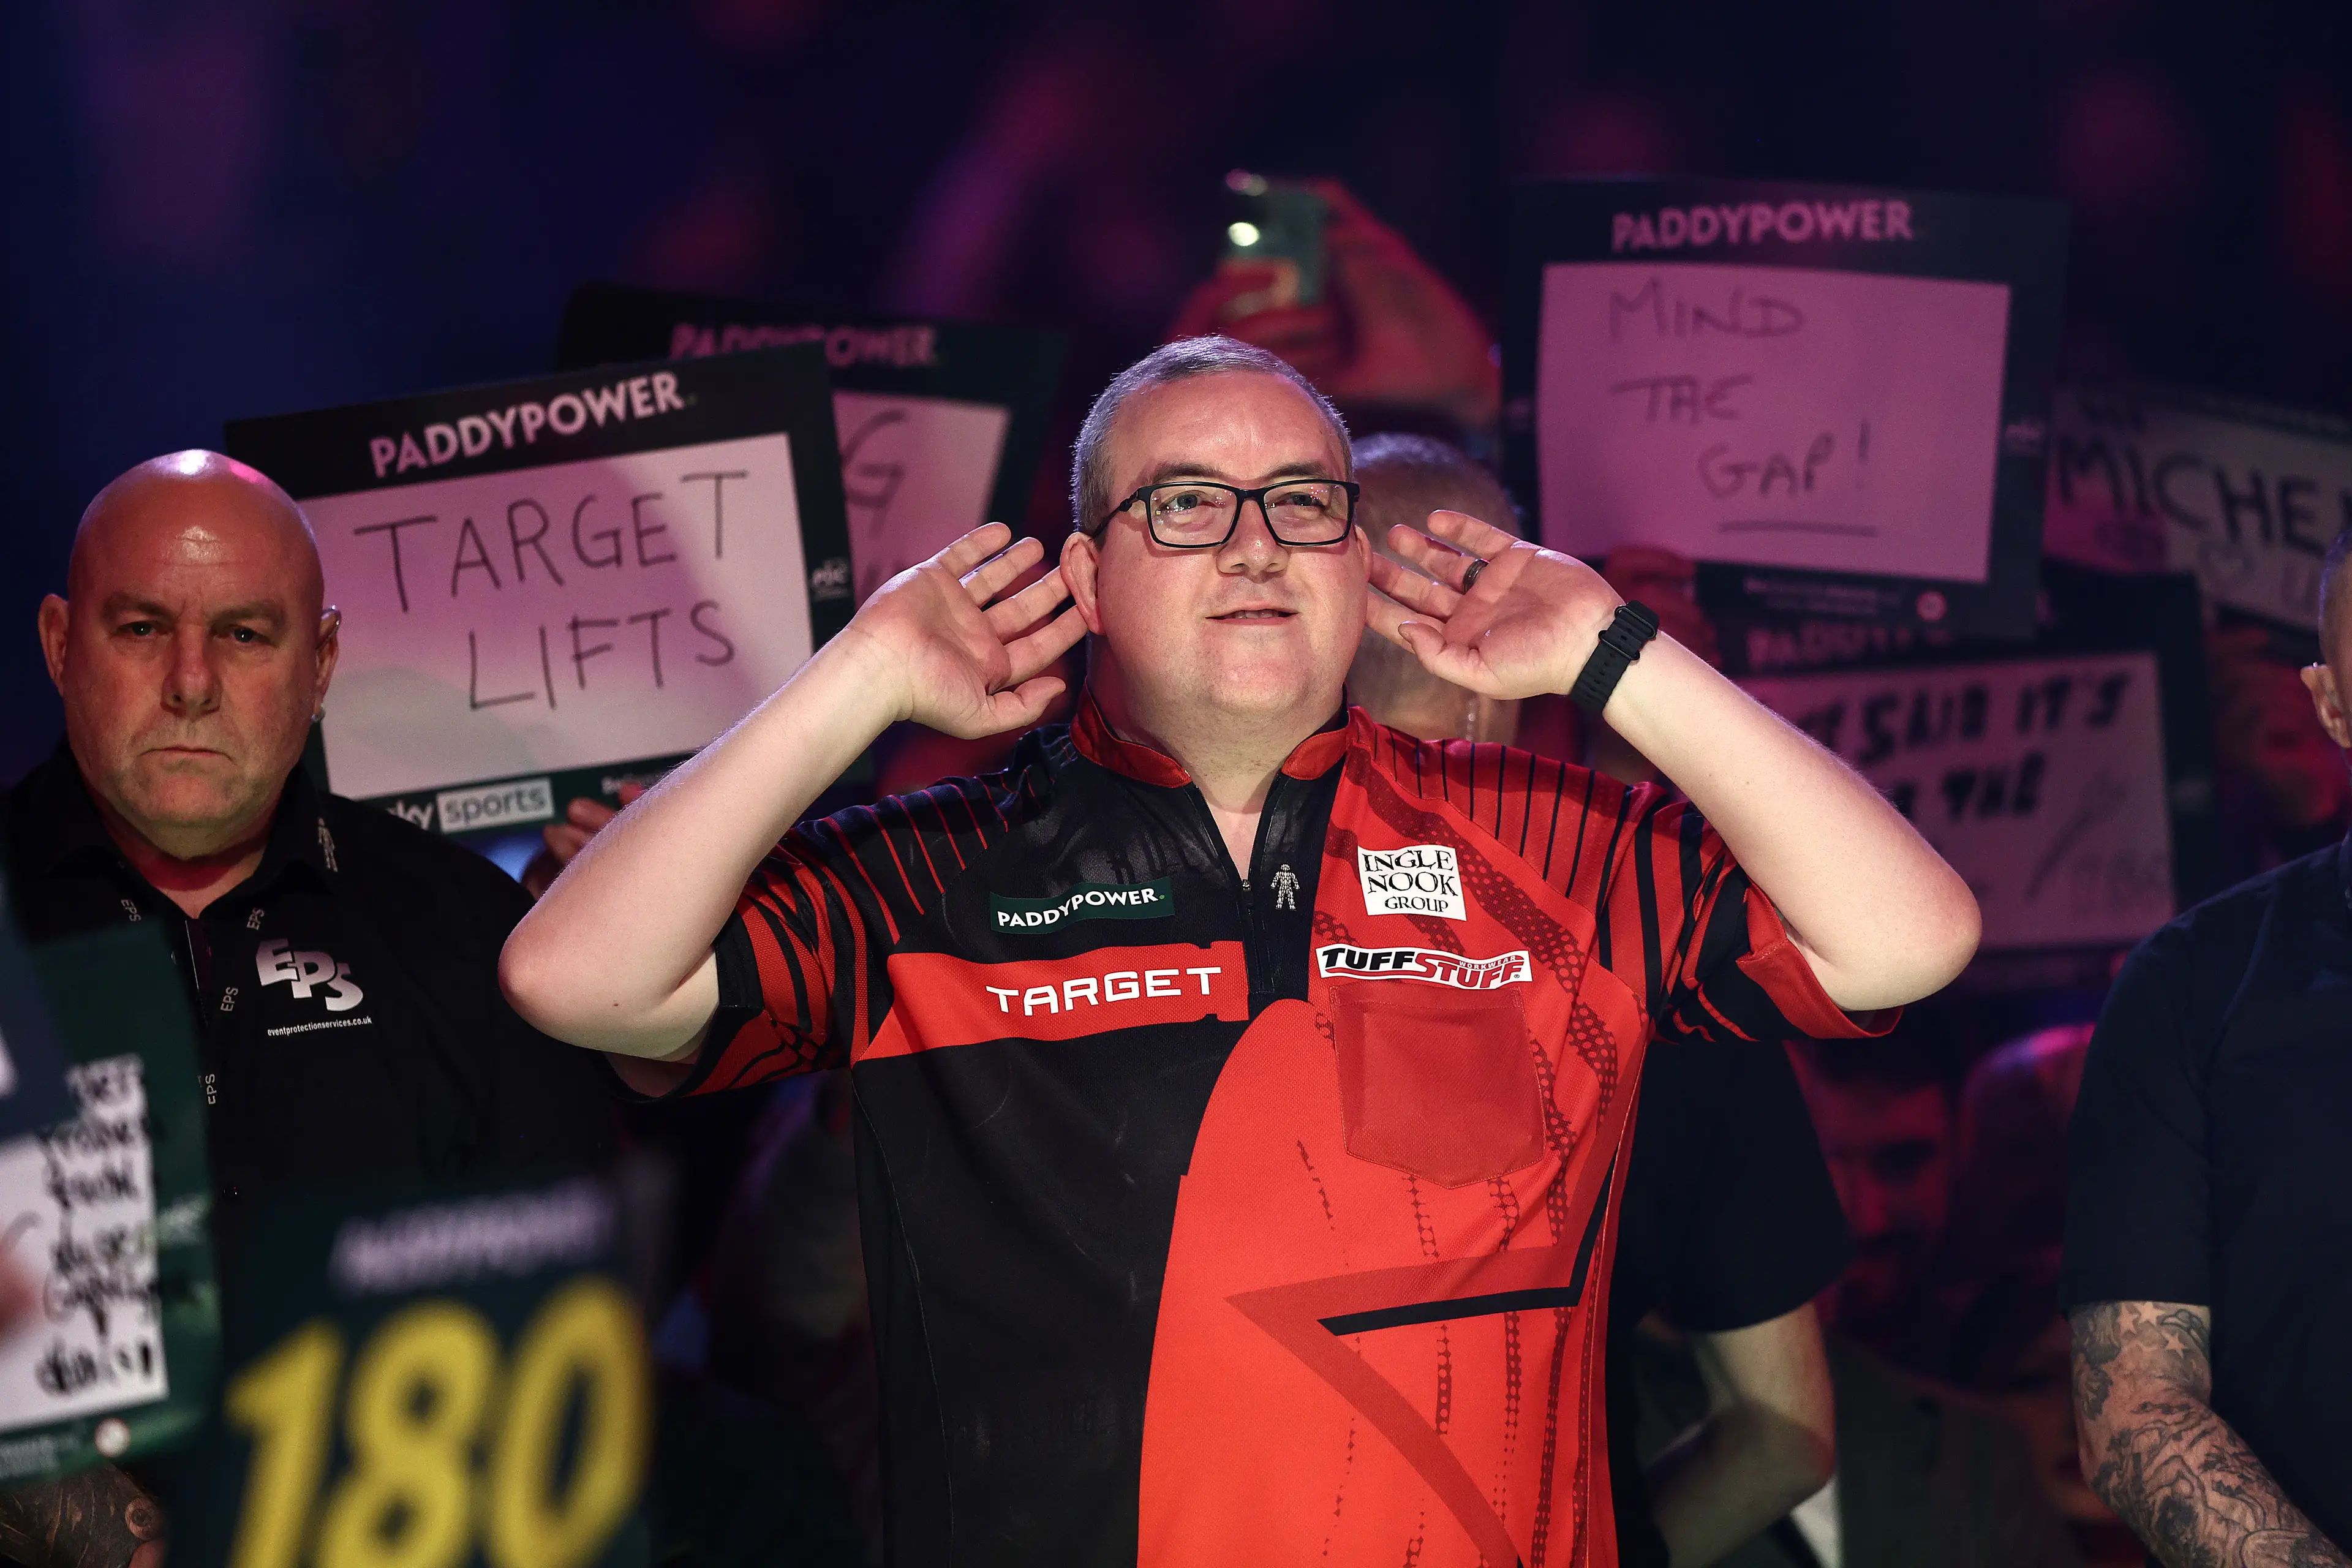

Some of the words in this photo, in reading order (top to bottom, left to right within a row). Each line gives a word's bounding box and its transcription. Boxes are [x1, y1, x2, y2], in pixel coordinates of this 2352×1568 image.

[1610, 277, 1804, 341] MIND
[353, 470, 748, 612] TARGET
[468, 599, 734, 711] LIFTS
[1858, 681, 1988, 764] SAID
[1943, 751, 2046, 818] THE
[385, 799, 434, 831] ky
[444, 785, 546, 825] sports
[1363, 849, 1455, 872] INGLE
[1367, 872, 1459, 897] NOOK
[121, 899, 141, 922] EPS
[247, 907, 265, 931] EPS
[1384, 896, 1449, 913] GROUP
[255, 937, 364, 1012] EPS
[1458, 955, 1517, 970] WORKWEAR
[220, 986, 238, 1012] EPS
[985, 967, 1222, 1017] TARGET
[267, 1014, 373, 1037] eventprotectionservices.co.uk
[205, 1073, 217, 1105] EPS
[224, 1274, 655, 1568] 180
